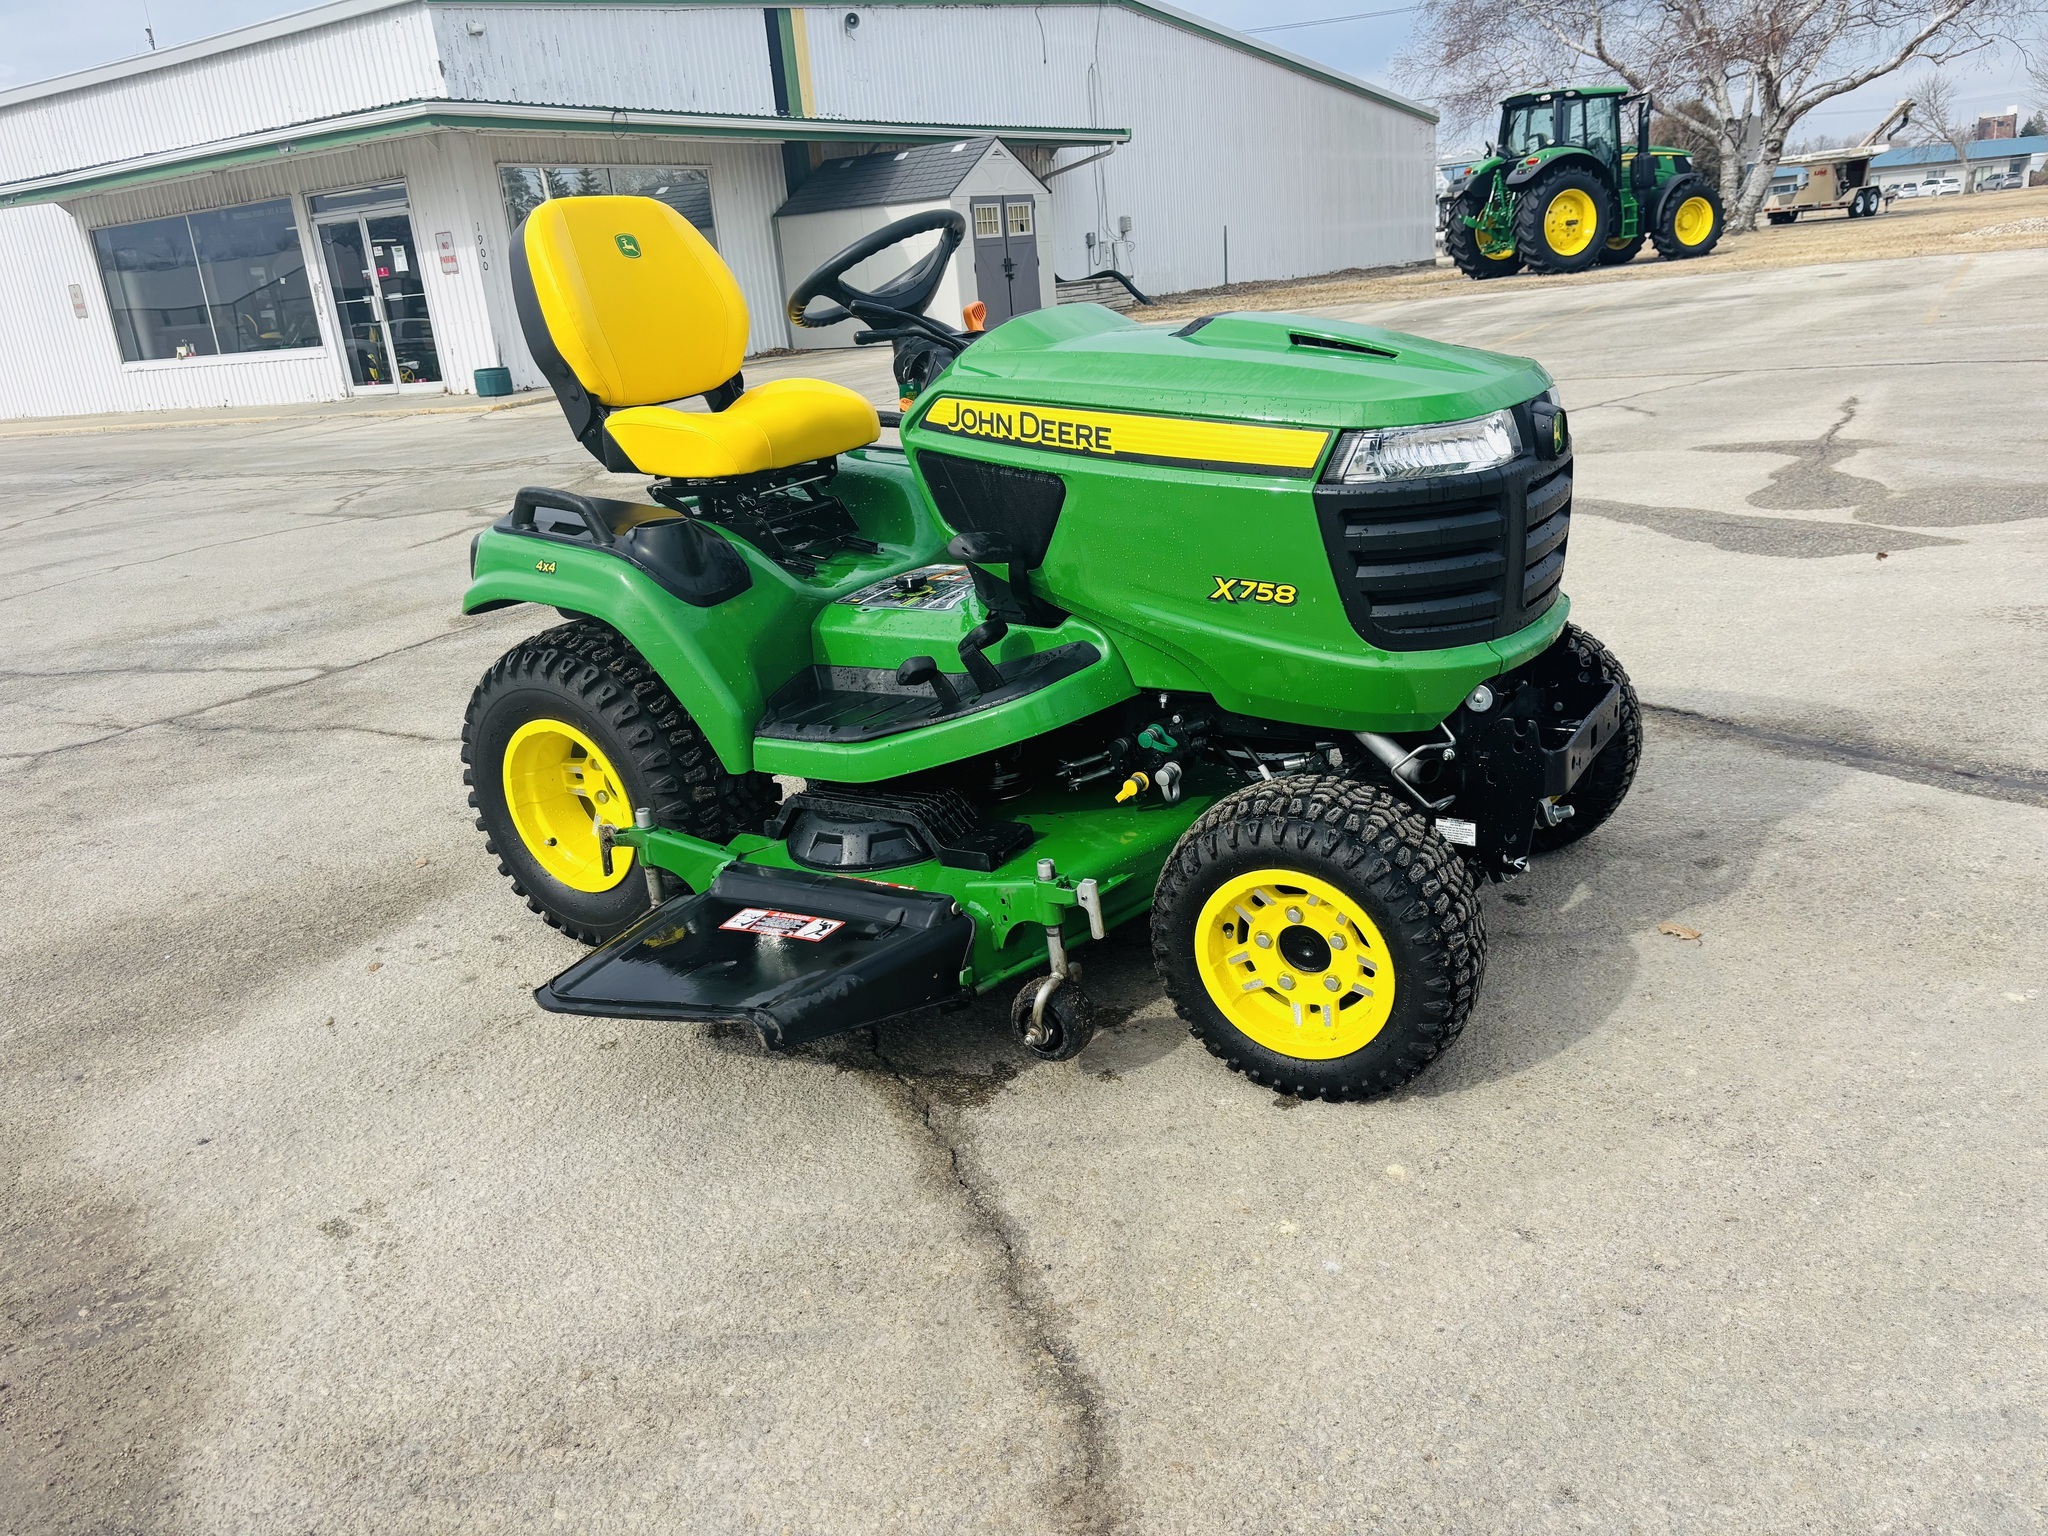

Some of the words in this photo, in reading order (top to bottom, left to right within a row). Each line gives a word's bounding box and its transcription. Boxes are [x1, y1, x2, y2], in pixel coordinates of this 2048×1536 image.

[441, 241, 450, 250] NO
[476, 221, 489, 271] 1900
[948, 402, 1013, 437] JOHN
[1019, 411, 1112, 451] DEERE
[535, 559, 556, 574] 4x4
[1207, 575, 1298, 606] X758
